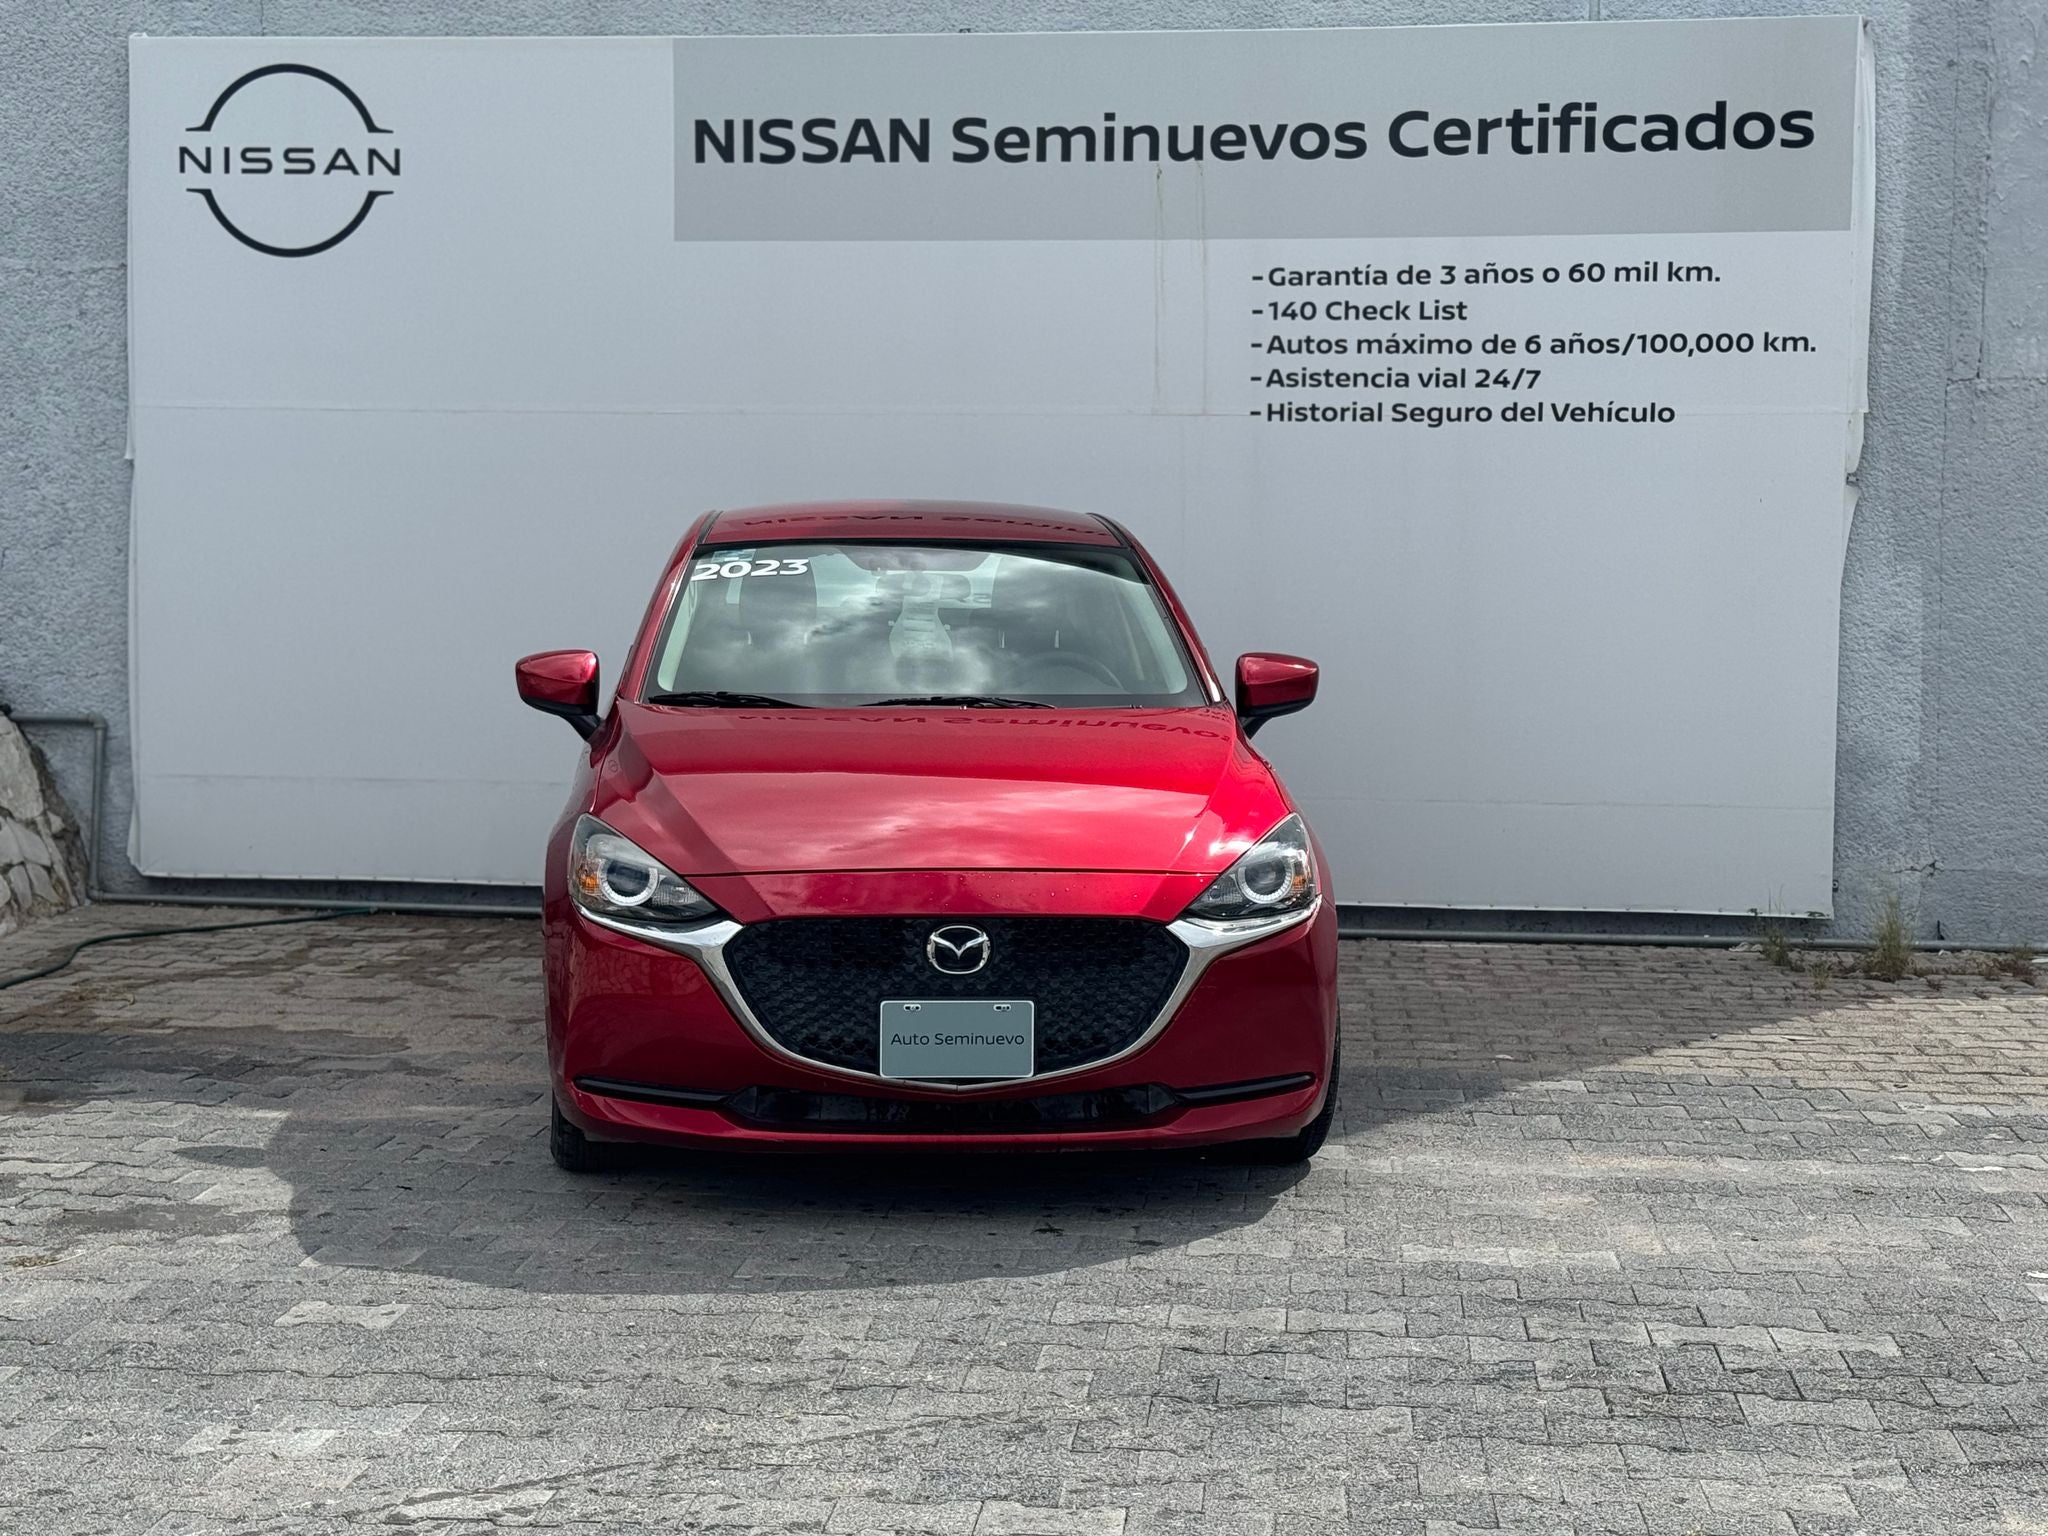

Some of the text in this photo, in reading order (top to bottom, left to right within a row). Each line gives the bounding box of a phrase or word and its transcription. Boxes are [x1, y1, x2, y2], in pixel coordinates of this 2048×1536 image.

[694, 100, 1815, 165] NISSAN Seminuevos Certificados
[179, 146, 401, 176] NISSAN
[1397, 264, 1432, 285] de
[1439, 265, 1456, 285] 3
[1464, 262, 1534, 285] años
[1542, 267, 1560, 283] o
[1568, 262, 1606, 283] 60
[1614, 260, 1658, 283] mil
[1667, 261, 1721, 282] km.
[1325, 300, 1411, 321] Check
[1419, 299, 1468, 321] List
[1356, 332, 1473, 355] máximo
[1481, 333, 1517, 355] de
[1524, 334, 1542, 355] 6
[1550, 332, 1754, 359] años/100,000
[1763, 331, 1816, 353] km.
[1417, 367, 1466, 389] vial
[1474, 367, 1542, 391] 24/7
[1391, 402, 1493, 428] Seguro
[1500, 401, 1544, 423] del
[1550, 400, 1676, 423] Vehículo
[690, 558, 809, 582] 2023
[890, 1031, 1026, 1047] Auto Seminuevo
